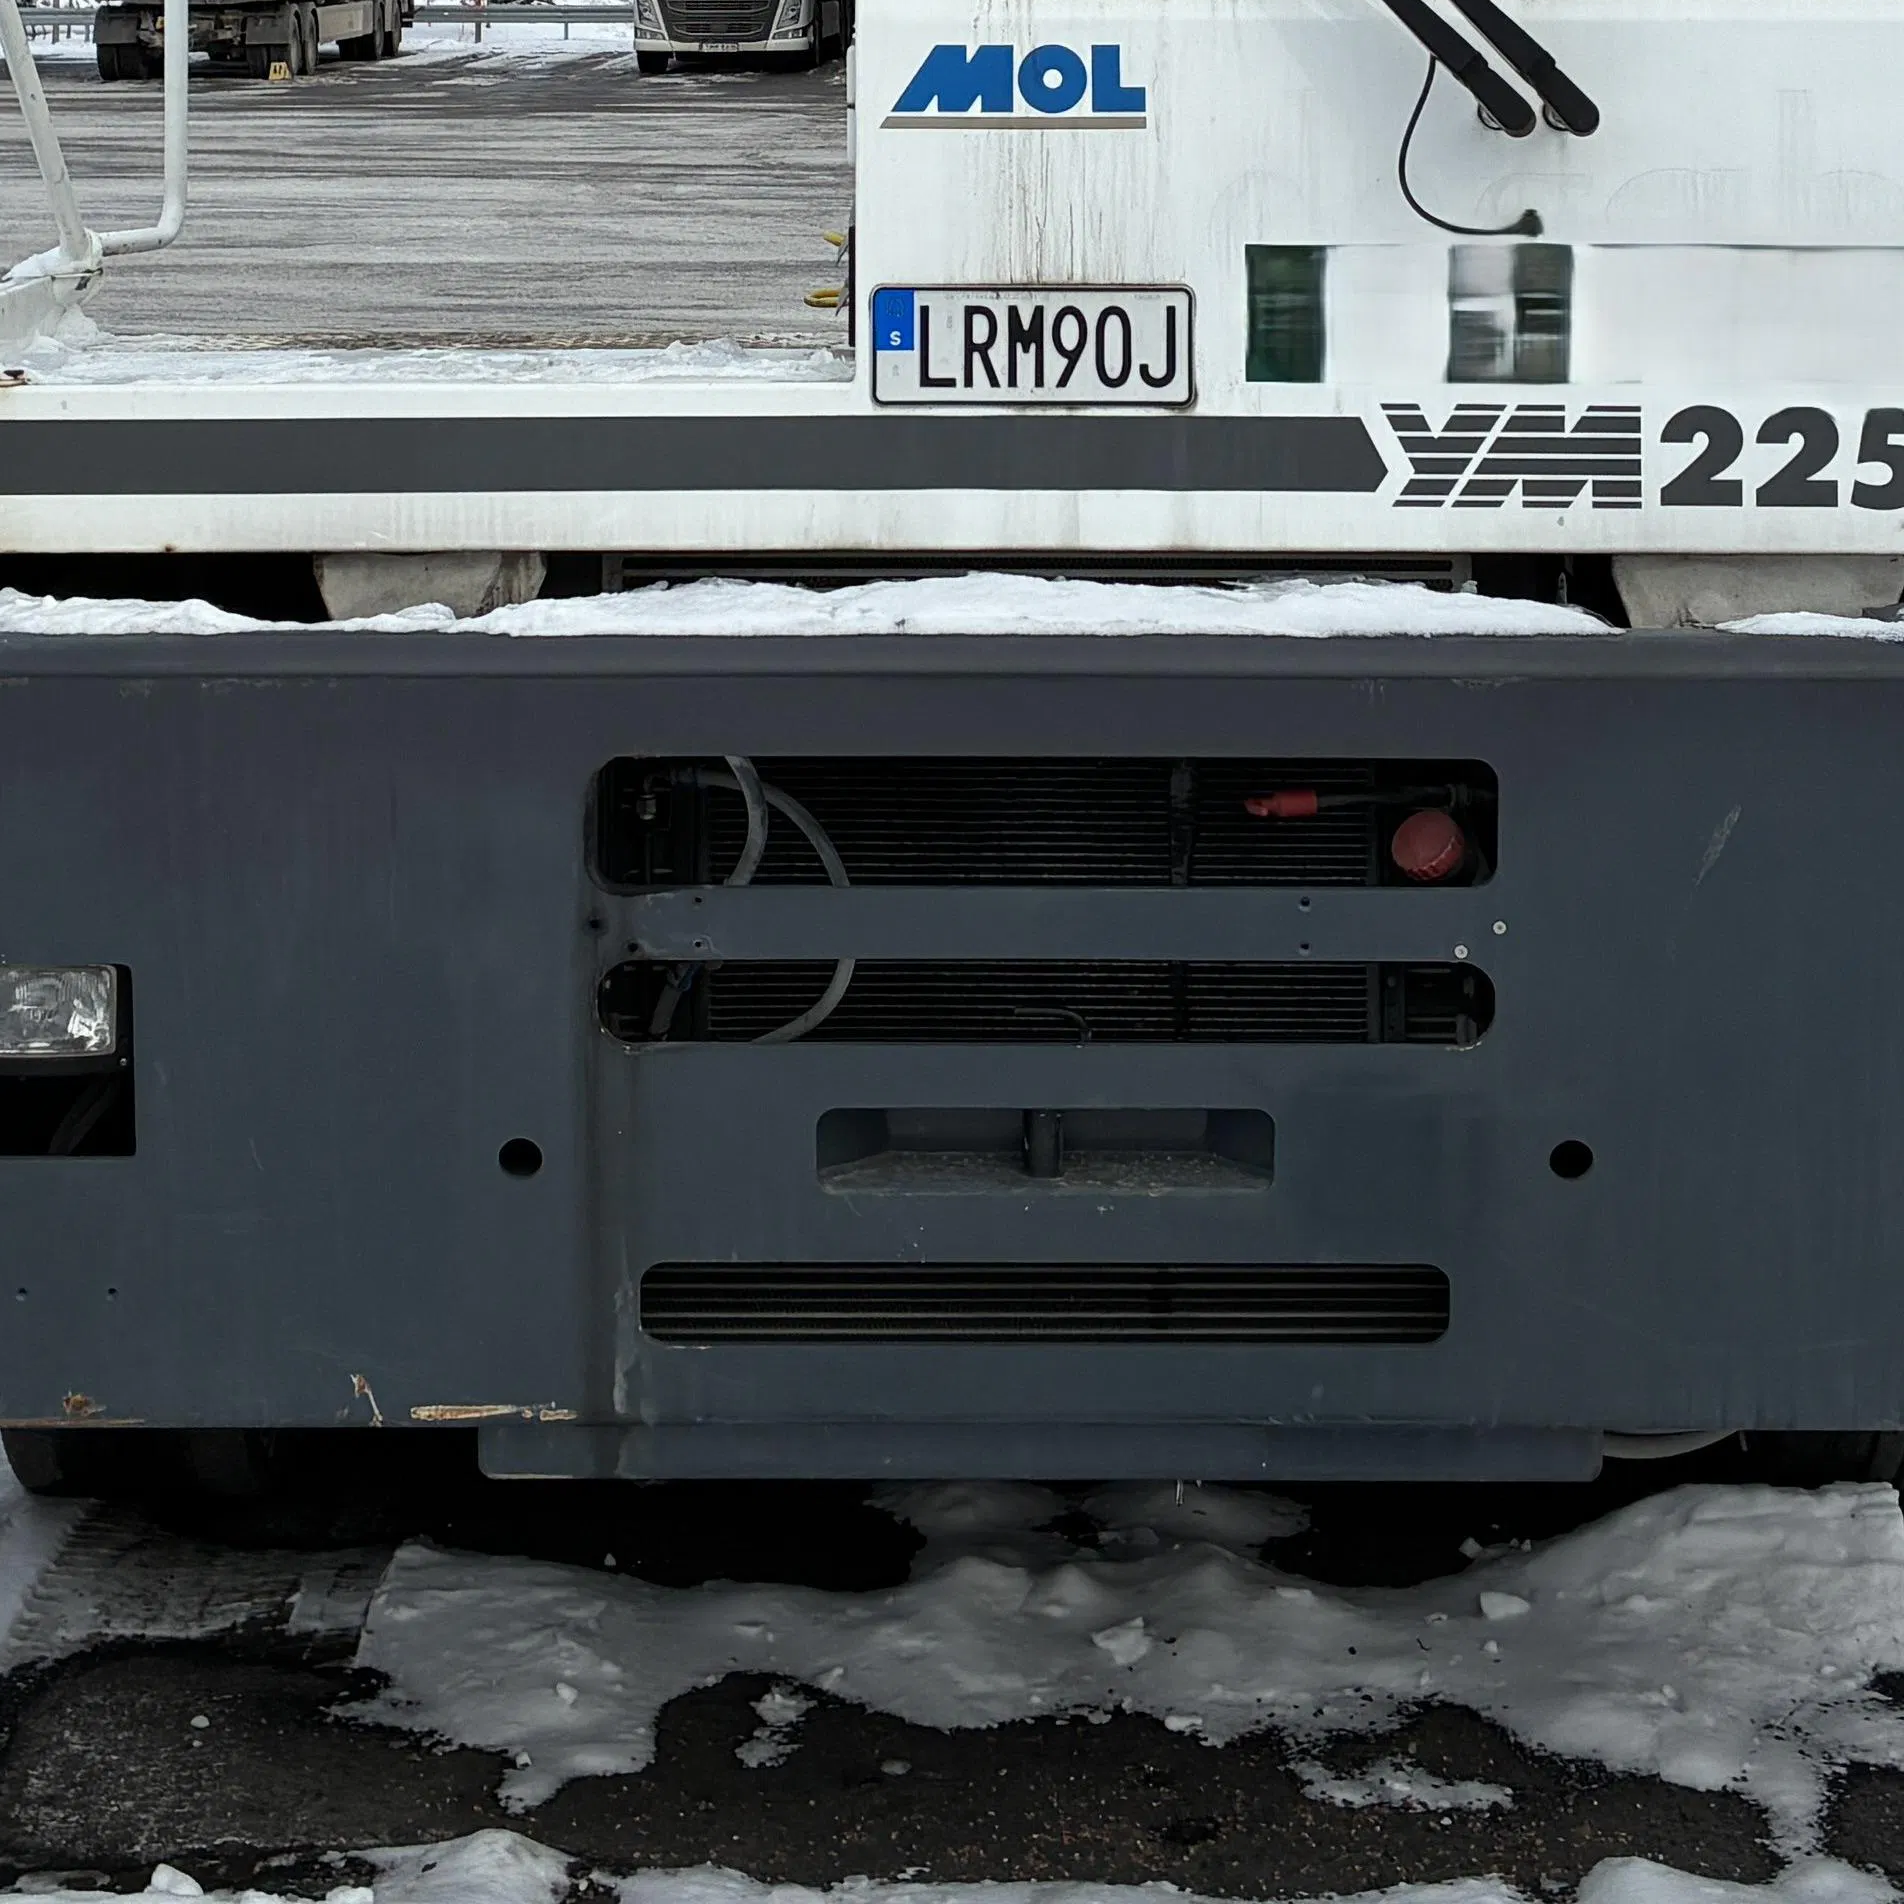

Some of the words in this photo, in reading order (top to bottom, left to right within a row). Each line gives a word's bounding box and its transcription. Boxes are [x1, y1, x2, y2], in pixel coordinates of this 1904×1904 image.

[892, 44, 1146, 114] MOL
[889, 331, 901, 346] S
[919, 304, 1176, 388] LRM90J
